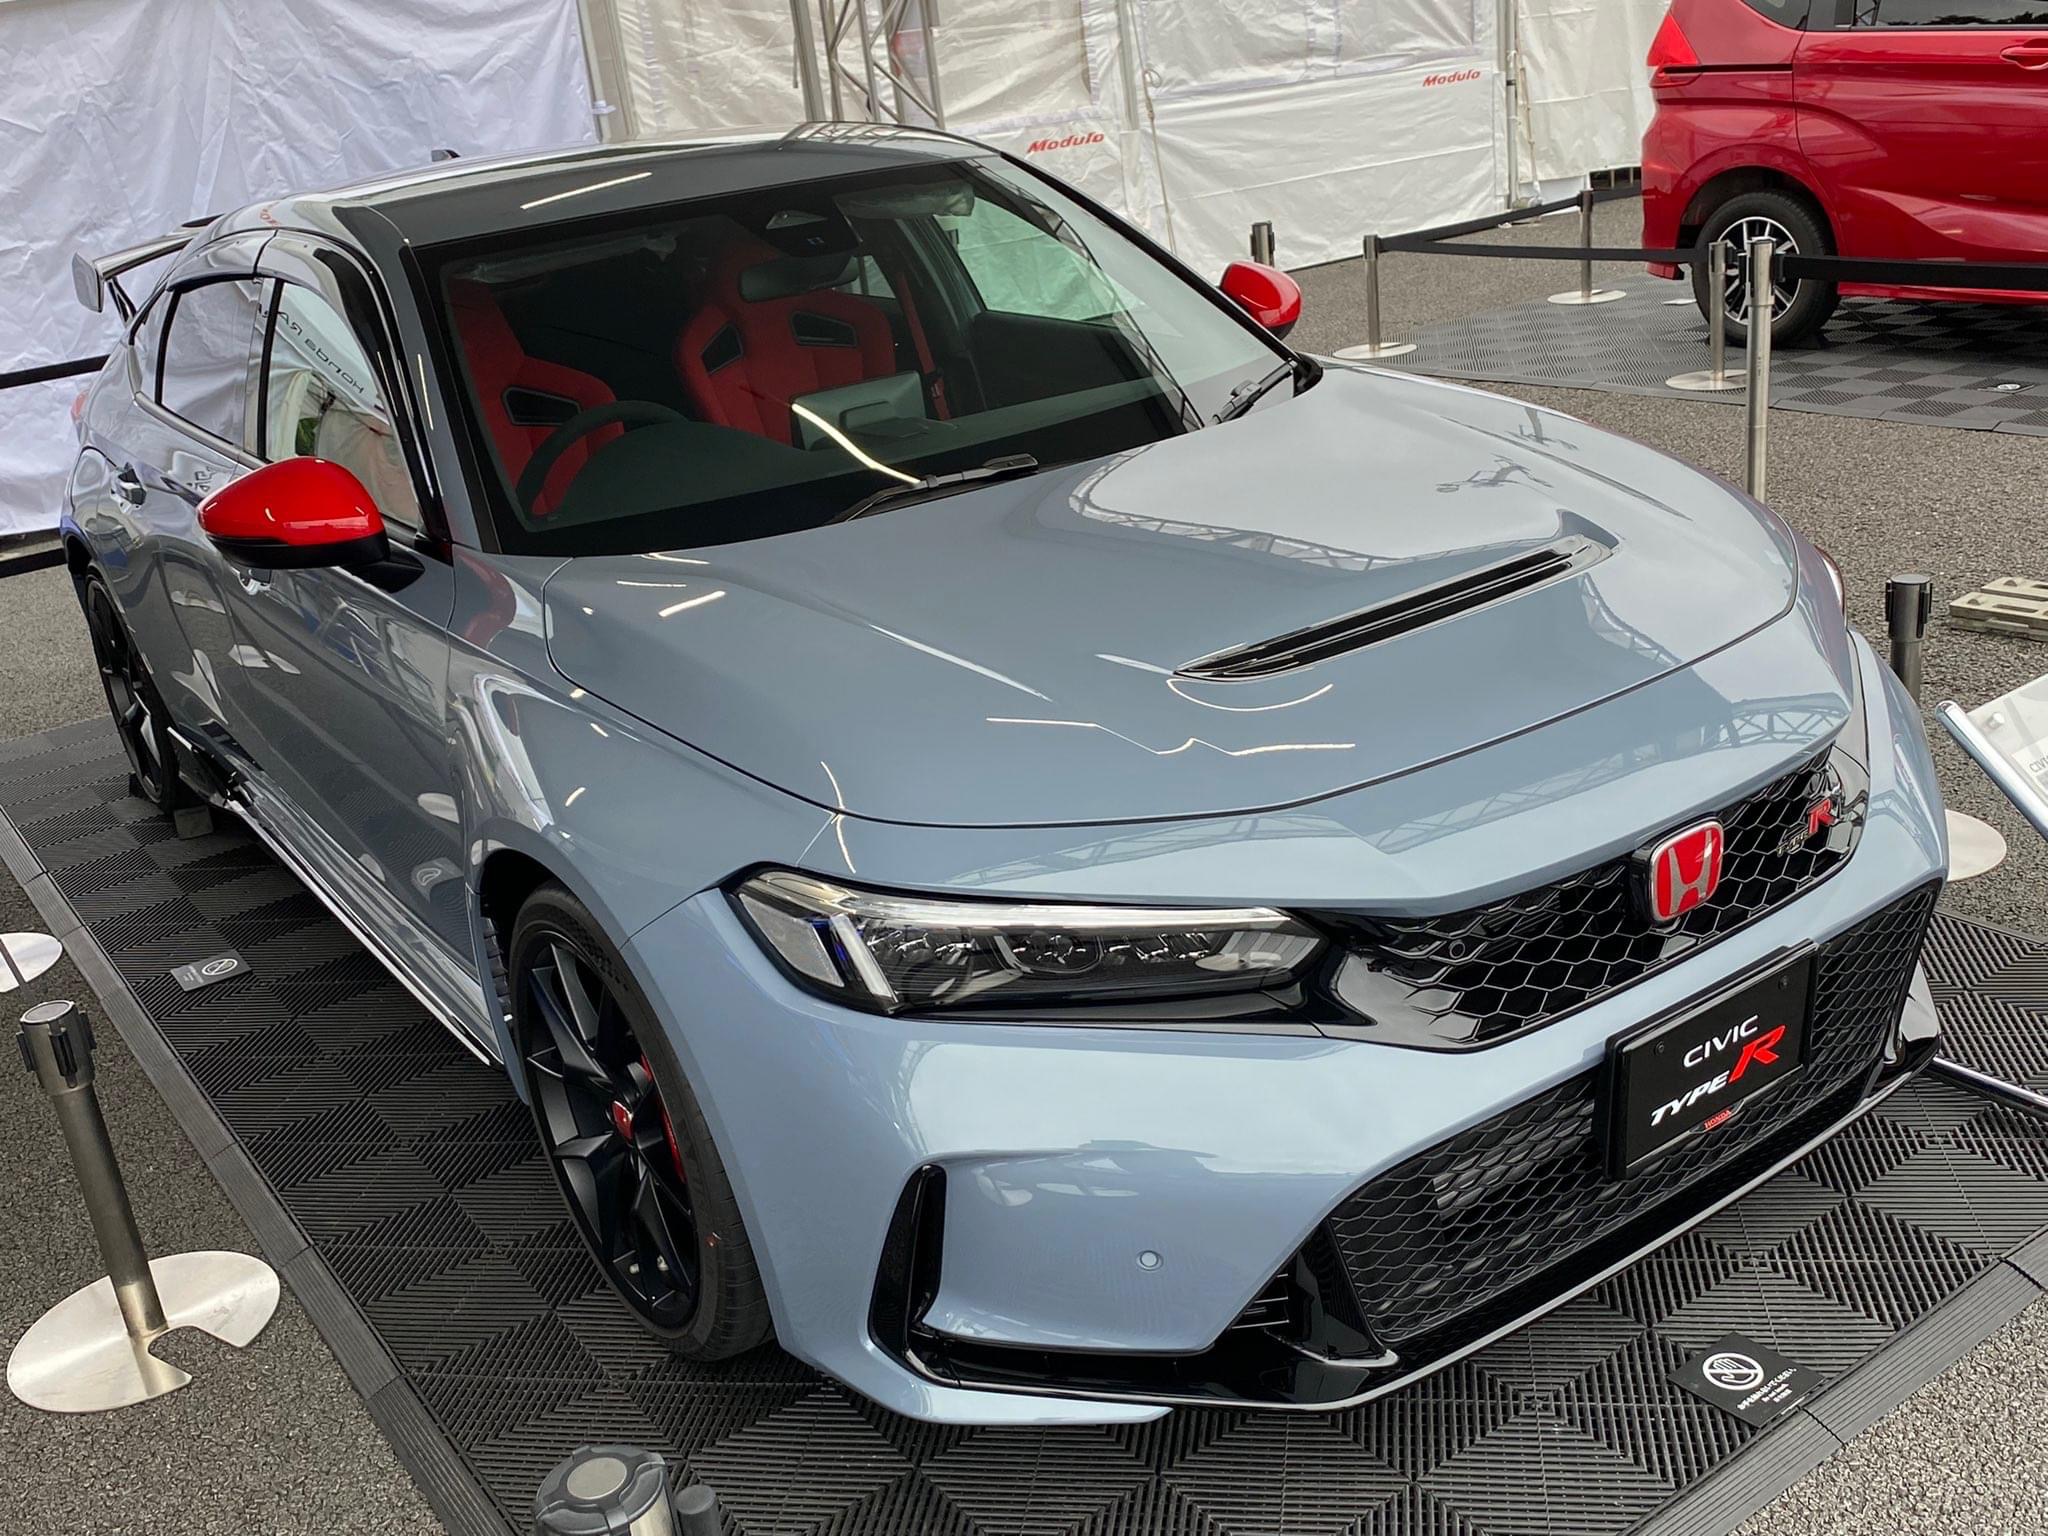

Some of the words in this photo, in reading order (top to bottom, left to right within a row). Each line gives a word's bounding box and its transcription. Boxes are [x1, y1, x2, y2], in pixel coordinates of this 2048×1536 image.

[1422, 69, 1480, 87] Modulo
[1027, 132, 1105, 153] Modulo
[1683, 1014, 1759, 1068] CIVIC
[1651, 1069, 1730, 1127] TYPE
[1728, 1024, 1786, 1084] R
[1704, 1109, 1732, 1129] HONDA
